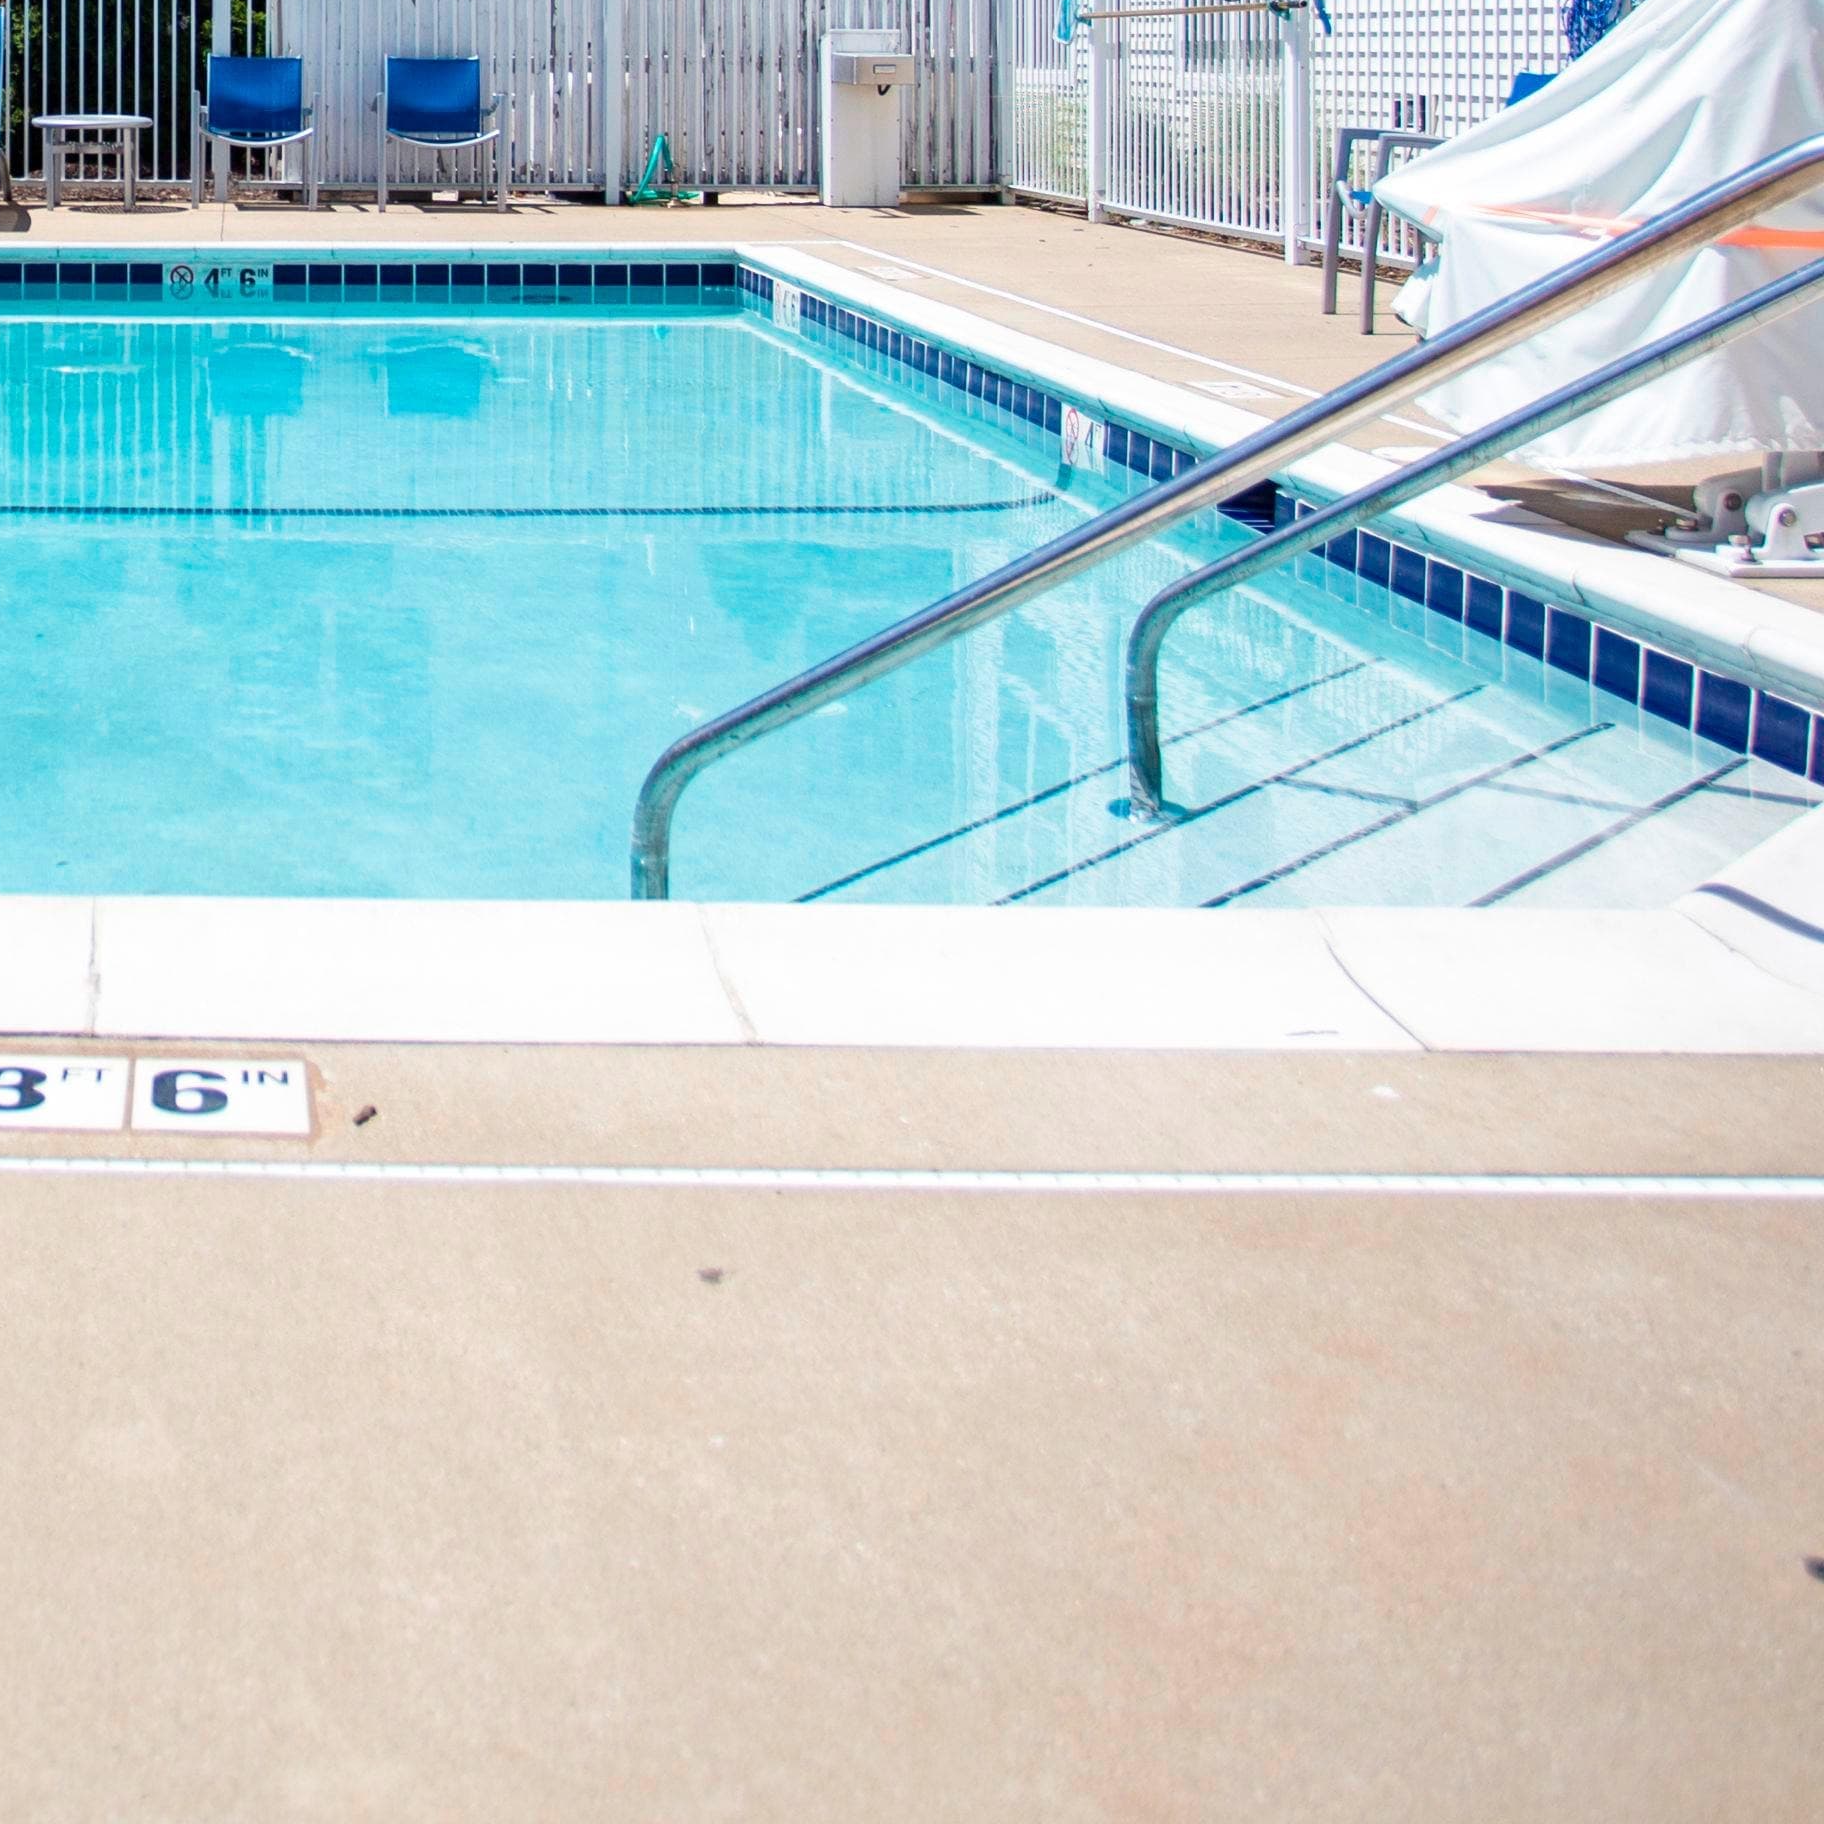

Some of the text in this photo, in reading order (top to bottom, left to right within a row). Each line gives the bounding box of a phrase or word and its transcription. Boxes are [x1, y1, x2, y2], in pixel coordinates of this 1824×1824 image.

[204, 268, 269, 287] 4 FT 6 IN
[62, 1067, 112, 1082] FT
[152, 1069, 228, 1115] 6
[241, 1069, 288, 1085] IN
